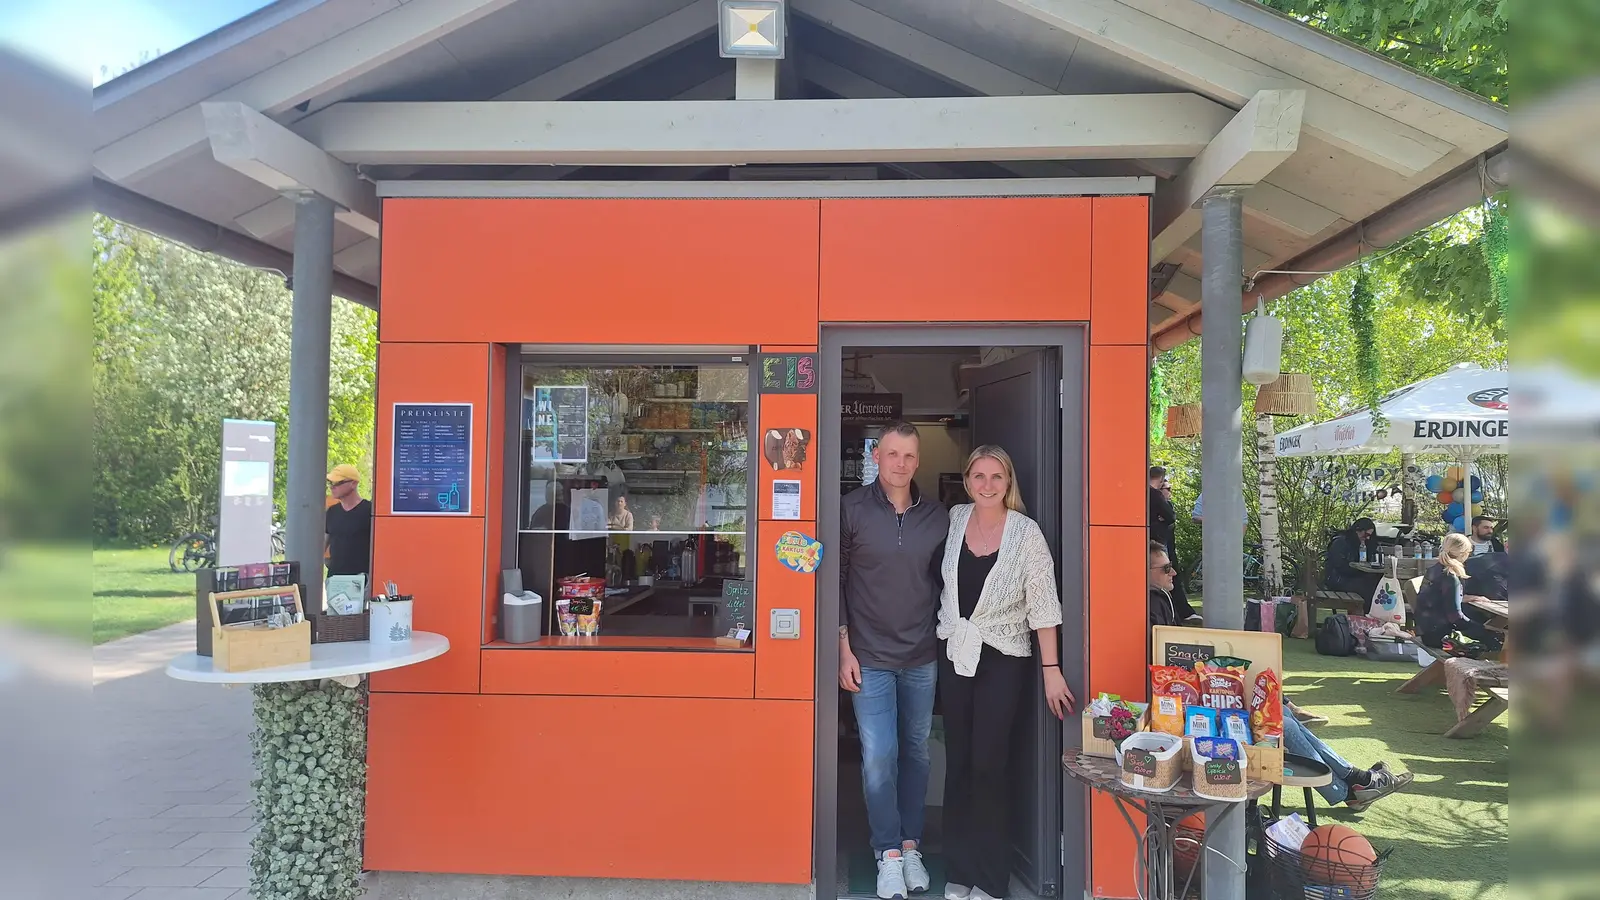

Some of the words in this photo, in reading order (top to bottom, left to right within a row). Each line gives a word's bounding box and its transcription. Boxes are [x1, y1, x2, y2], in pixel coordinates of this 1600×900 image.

[763, 356, 815, 389] EIS
[538, 414, 553, 426] NE
[1279, 434, 1302, 451] ERDINGER
[1413, 420, 1508, 440] ERDINGE
[782, 546, 804, 554] KAKTUS
[726, 582, 750, 597] Spritz
[1168, 645, 1210, 662] Snacks
[1202, 693, 1243, 709] CHIPS
[1192, 721, 1207, 730] MINI
